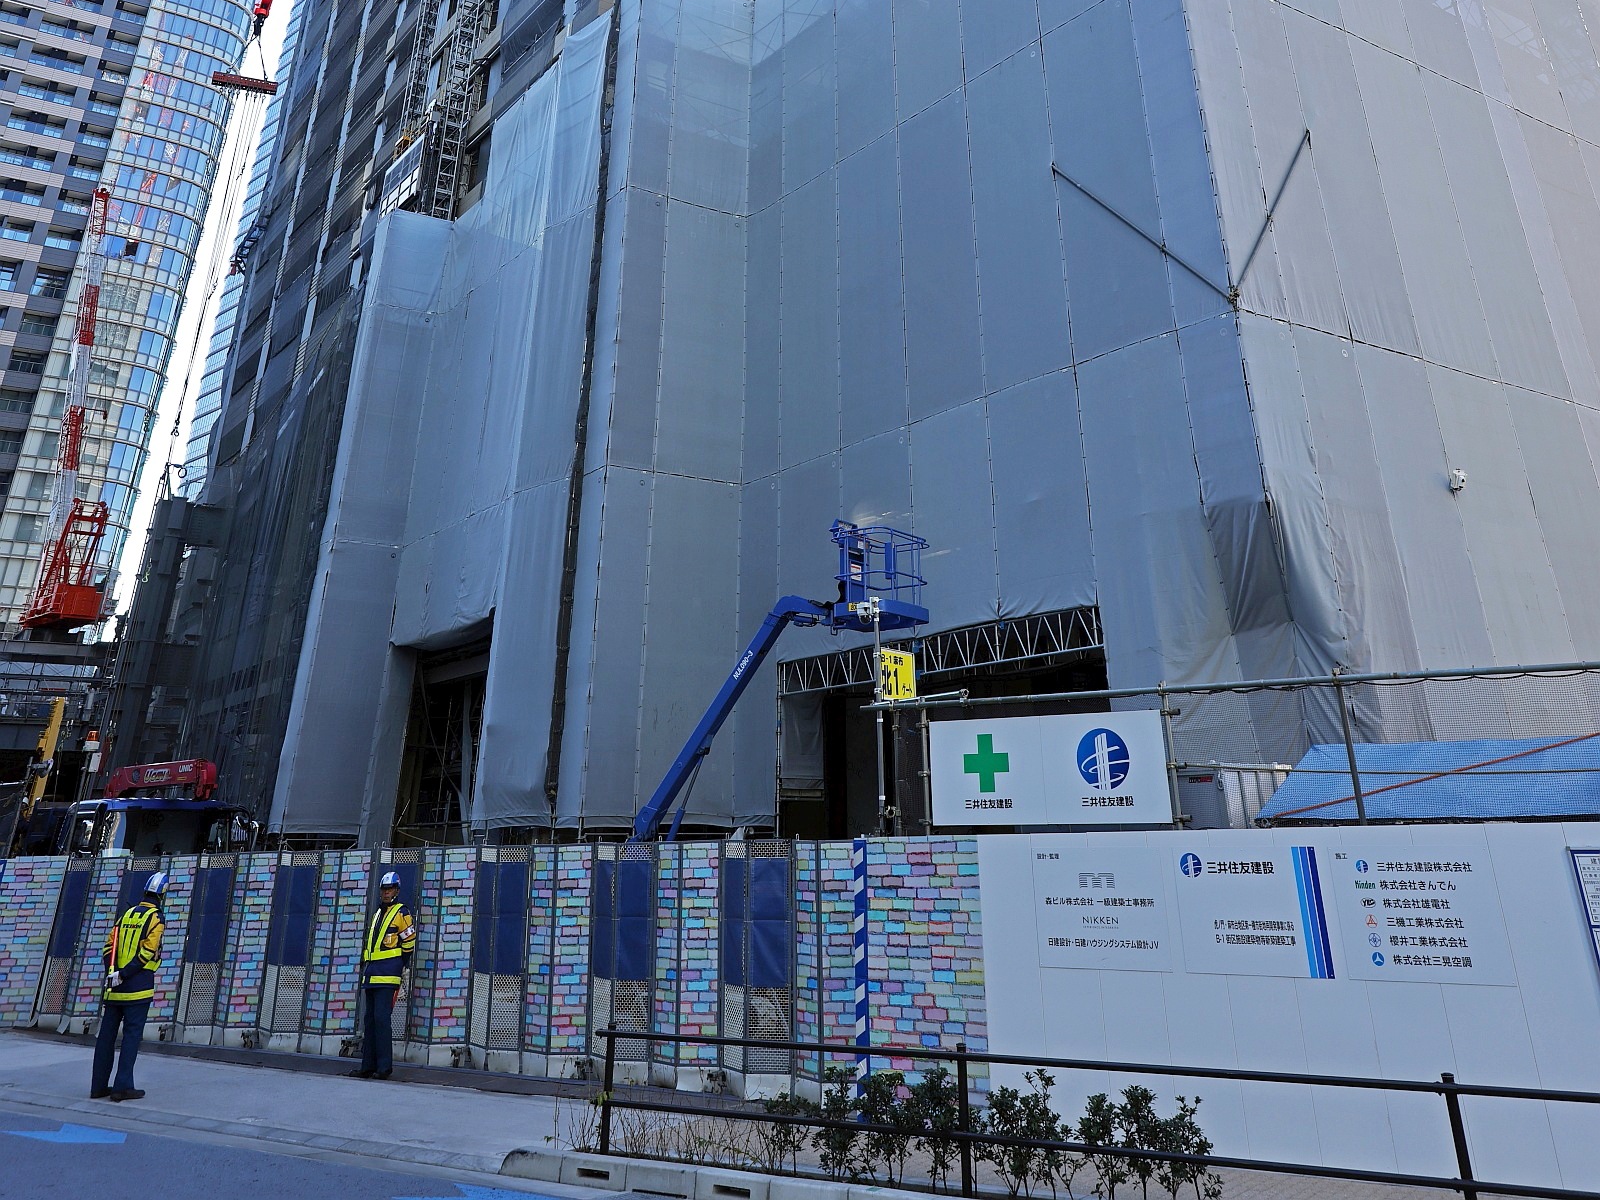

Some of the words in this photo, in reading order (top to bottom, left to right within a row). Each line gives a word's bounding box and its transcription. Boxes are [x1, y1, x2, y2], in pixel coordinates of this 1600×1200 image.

[178, 764, 193, 773] UNIC
[965, 798, 1014, 810] 三井住友建設
[1081, 796, 1135, 808] 三井住友建設
[1206, 861, 1275, 875] 三井住友建設
[1376, 861, 1473, 873] 三井住友建設株式会社
[1379, 879, 1457, 891] 株式会社きんでん
[1045, 896, 1094, 907] 森ビル株式会社
[1096, 897, 1155, 908] 一級建築士事務所
[1382, 898, 1451, 910] 株式会社雄電社
[1082, 916, 1119, 925] NIKKEN
[1386, 916, 1465, 929] 三機工業株式会社
[1393, 954, 1473, 968] 株式会社三晃空調
